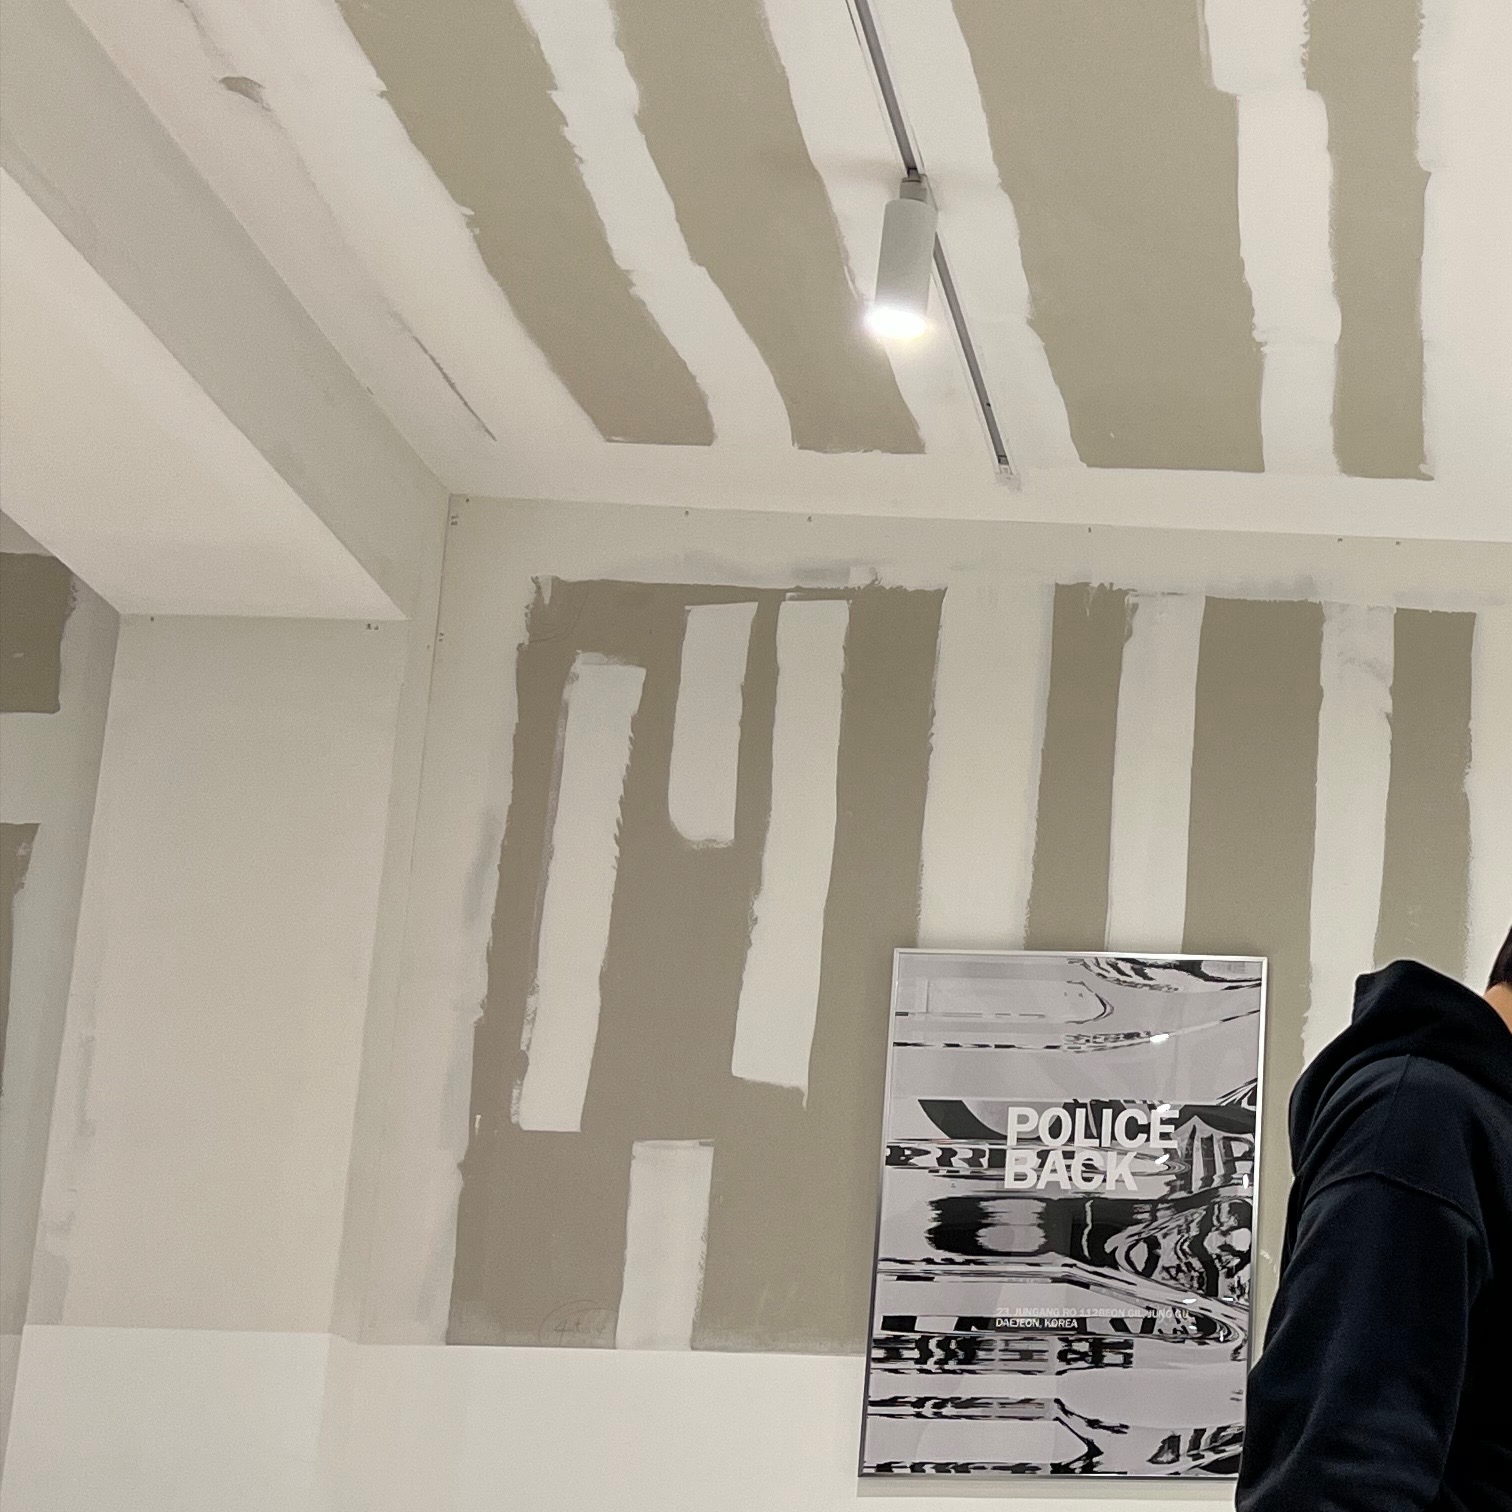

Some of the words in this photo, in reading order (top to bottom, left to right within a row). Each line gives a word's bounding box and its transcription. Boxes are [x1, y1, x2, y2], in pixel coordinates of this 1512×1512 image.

[1007, 1106, 1180, 1149] POLICE
[1004, 1149, 1138, 1191] BACK
[995, 1318, 1042, 1328] DAEJEON,
[1044, 1318, 1078, 1328] KOREA
[1062, 1307, 1077, 1317] RO
